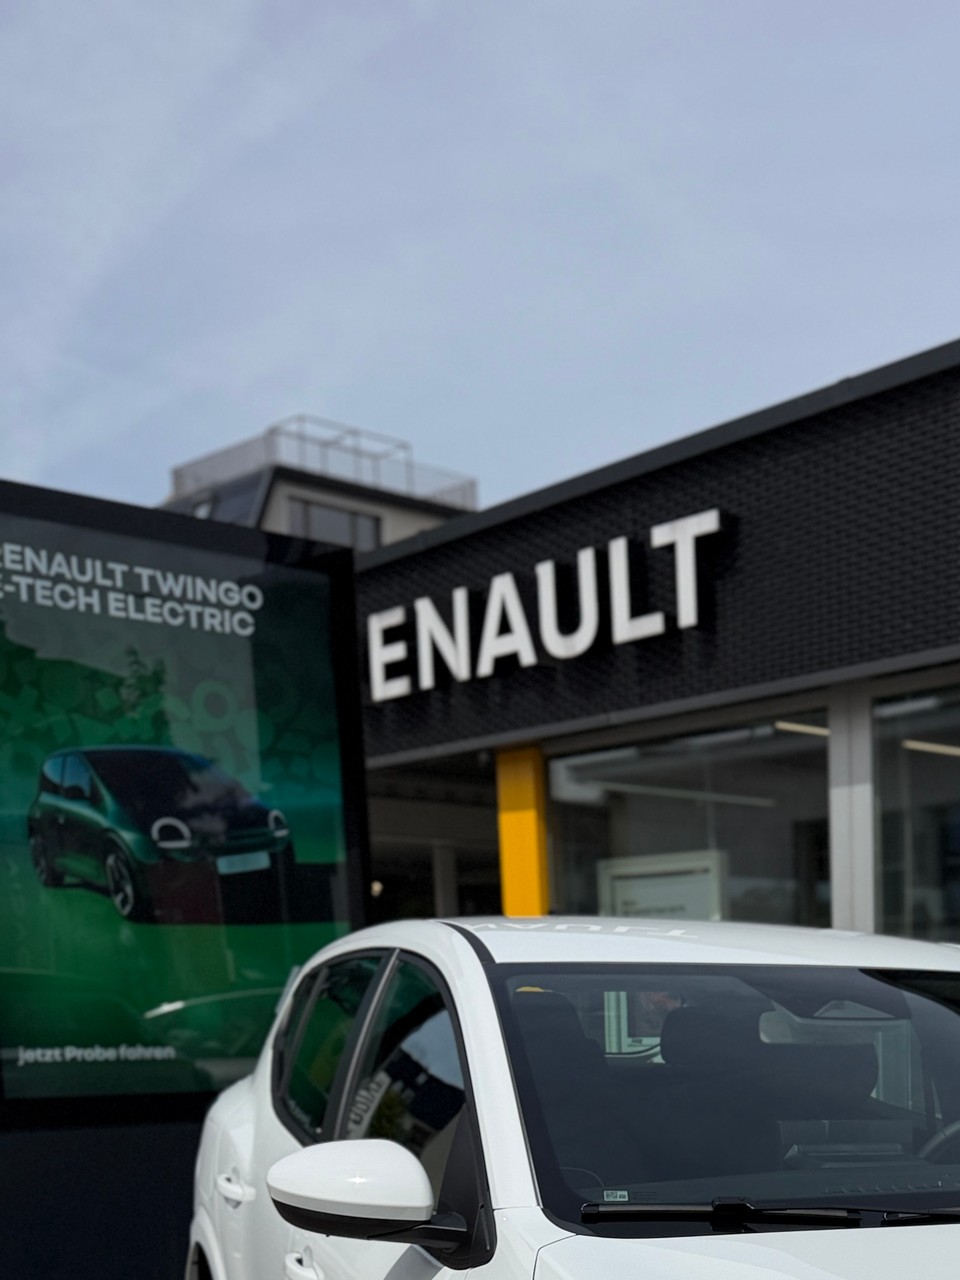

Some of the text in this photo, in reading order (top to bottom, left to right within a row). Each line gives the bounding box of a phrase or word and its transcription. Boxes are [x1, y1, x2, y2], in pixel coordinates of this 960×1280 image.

[0, 542, 264, 611] ENAULT TWINGO
[0, 574, 256, 637] -TECH ELECTRIC
[367, 508, 721, 702] ENAULT
[64, 1044, 117, 1062] Probe
[118, 1043, 176, 1061] fahren
